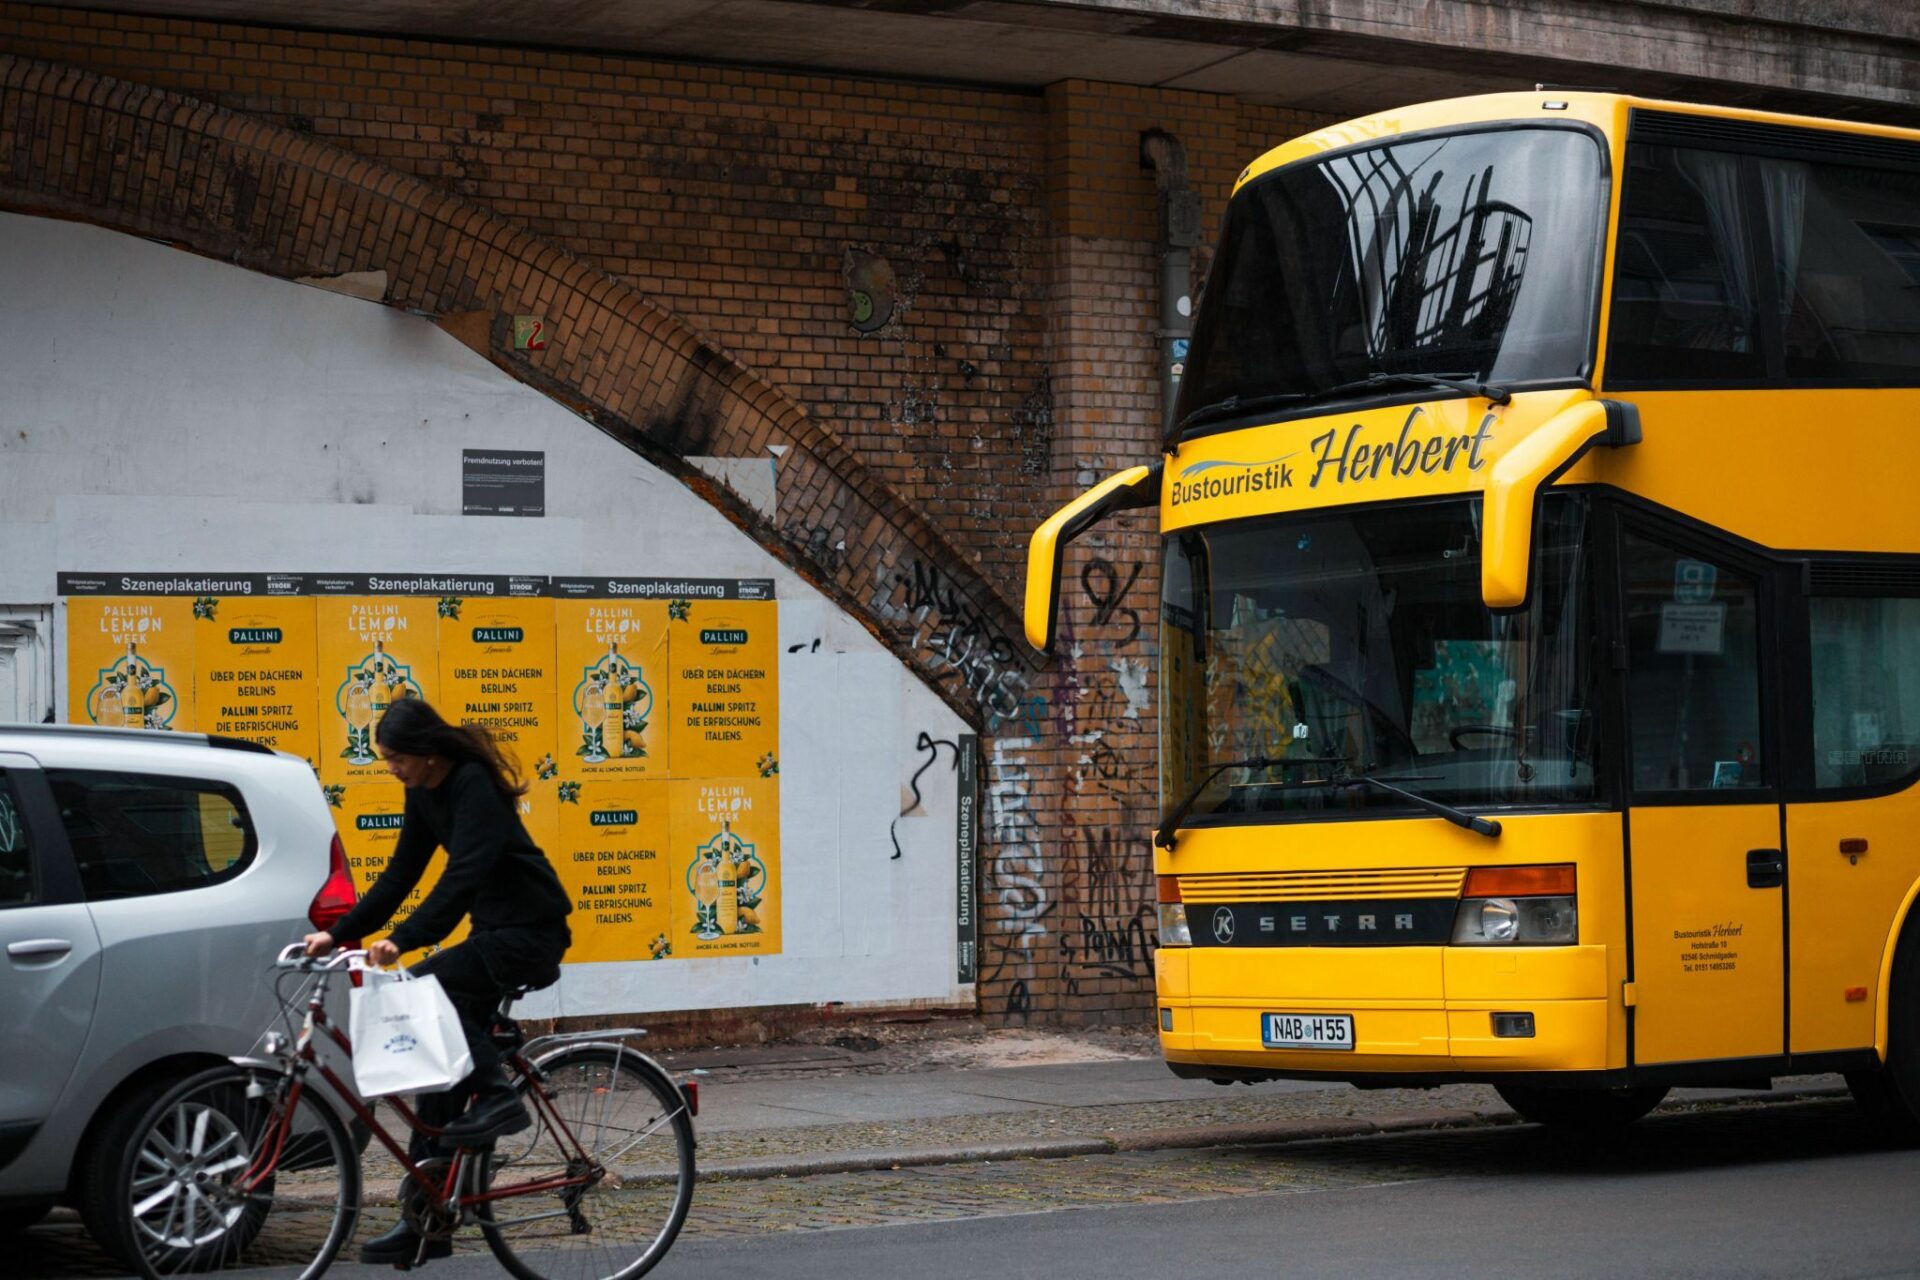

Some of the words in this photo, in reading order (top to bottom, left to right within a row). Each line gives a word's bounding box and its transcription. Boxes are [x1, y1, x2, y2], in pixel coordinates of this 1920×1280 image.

[1171, 463, 1293, 506] Bustouristik
[1309, 406, 1497, 489] Herbert
[464, 457, 510, 466] Fremdnutzung
[121, 577, 251, 594] Szeneplakatierung
[369, 577, 494, 594] Szeneplakatierung
[608, 581, 724, 597] Szeneplakatierung
[104, 606, 153, 616] PALLINI
[352, 605, 398, 615] PALLINI
[590, 608, 633, 618] PALLINI
[112, 633, 147, 644] WEEK
[234, 631, 278, 640] PALLINI
[360, 632, 393, 642] WEEK
[477, 630, 519, 640] PALLINI
[596, 633, 627, 644] WEEK
[704, 632, 744, 642] PALLINI
[238, 671, 256, 680] DEN
[481, 669, 499, 678] DEN
[707, 669, 724, 679] DEN
[238, 686, 276, 696] BERLINS
[481, 684, 517, 693] BERLINS
[707, 684, 741, 693] BERLINS
[222, 706, 258, 716] PALLINI
[262, 706, 293, 715] SPRITZ
[466, 703, 500, 712] PALLINI
[504, 702, 533, 712] SPRITZ
[692, 702, 725, 712] PALLINI
[728, 702, 756, 712] SPRITZ
[216, 722, 231, 732] DIE
[235, 720, 298, 731] ERFRISCHUNG
[687, 717, 700, 726] DIE
[704, 717, 761, 726] ERFRISCHUNG
[701, 786, 744, 797] PALLINI
[361, 816, 404, 827] PALLINI
[594, 813, 634, 823] PALLINI
[709, 812, 740, 823] WEEK
[598, 852, 614, 861] DEN
[958, 796, 972, 926] Szeneplakatierung
[366, 857, 384, 867] DEN
[597, 866, 631, 875] BERLINS
[583, 885, 615, 895] PALLINI
[618, 884, 647, 894] SPRITZ
[578, 901, 591, 910] DIE
[594, 898, 652, 909] ERFRISCHUNG
[1260, 914, 1413, 932] SETRA
[1674, 929, 1712, 938] Bustouristik
[1712, 921, 1743, 937] Herbert
[1274, 1017, 1304, 1040] NAB
